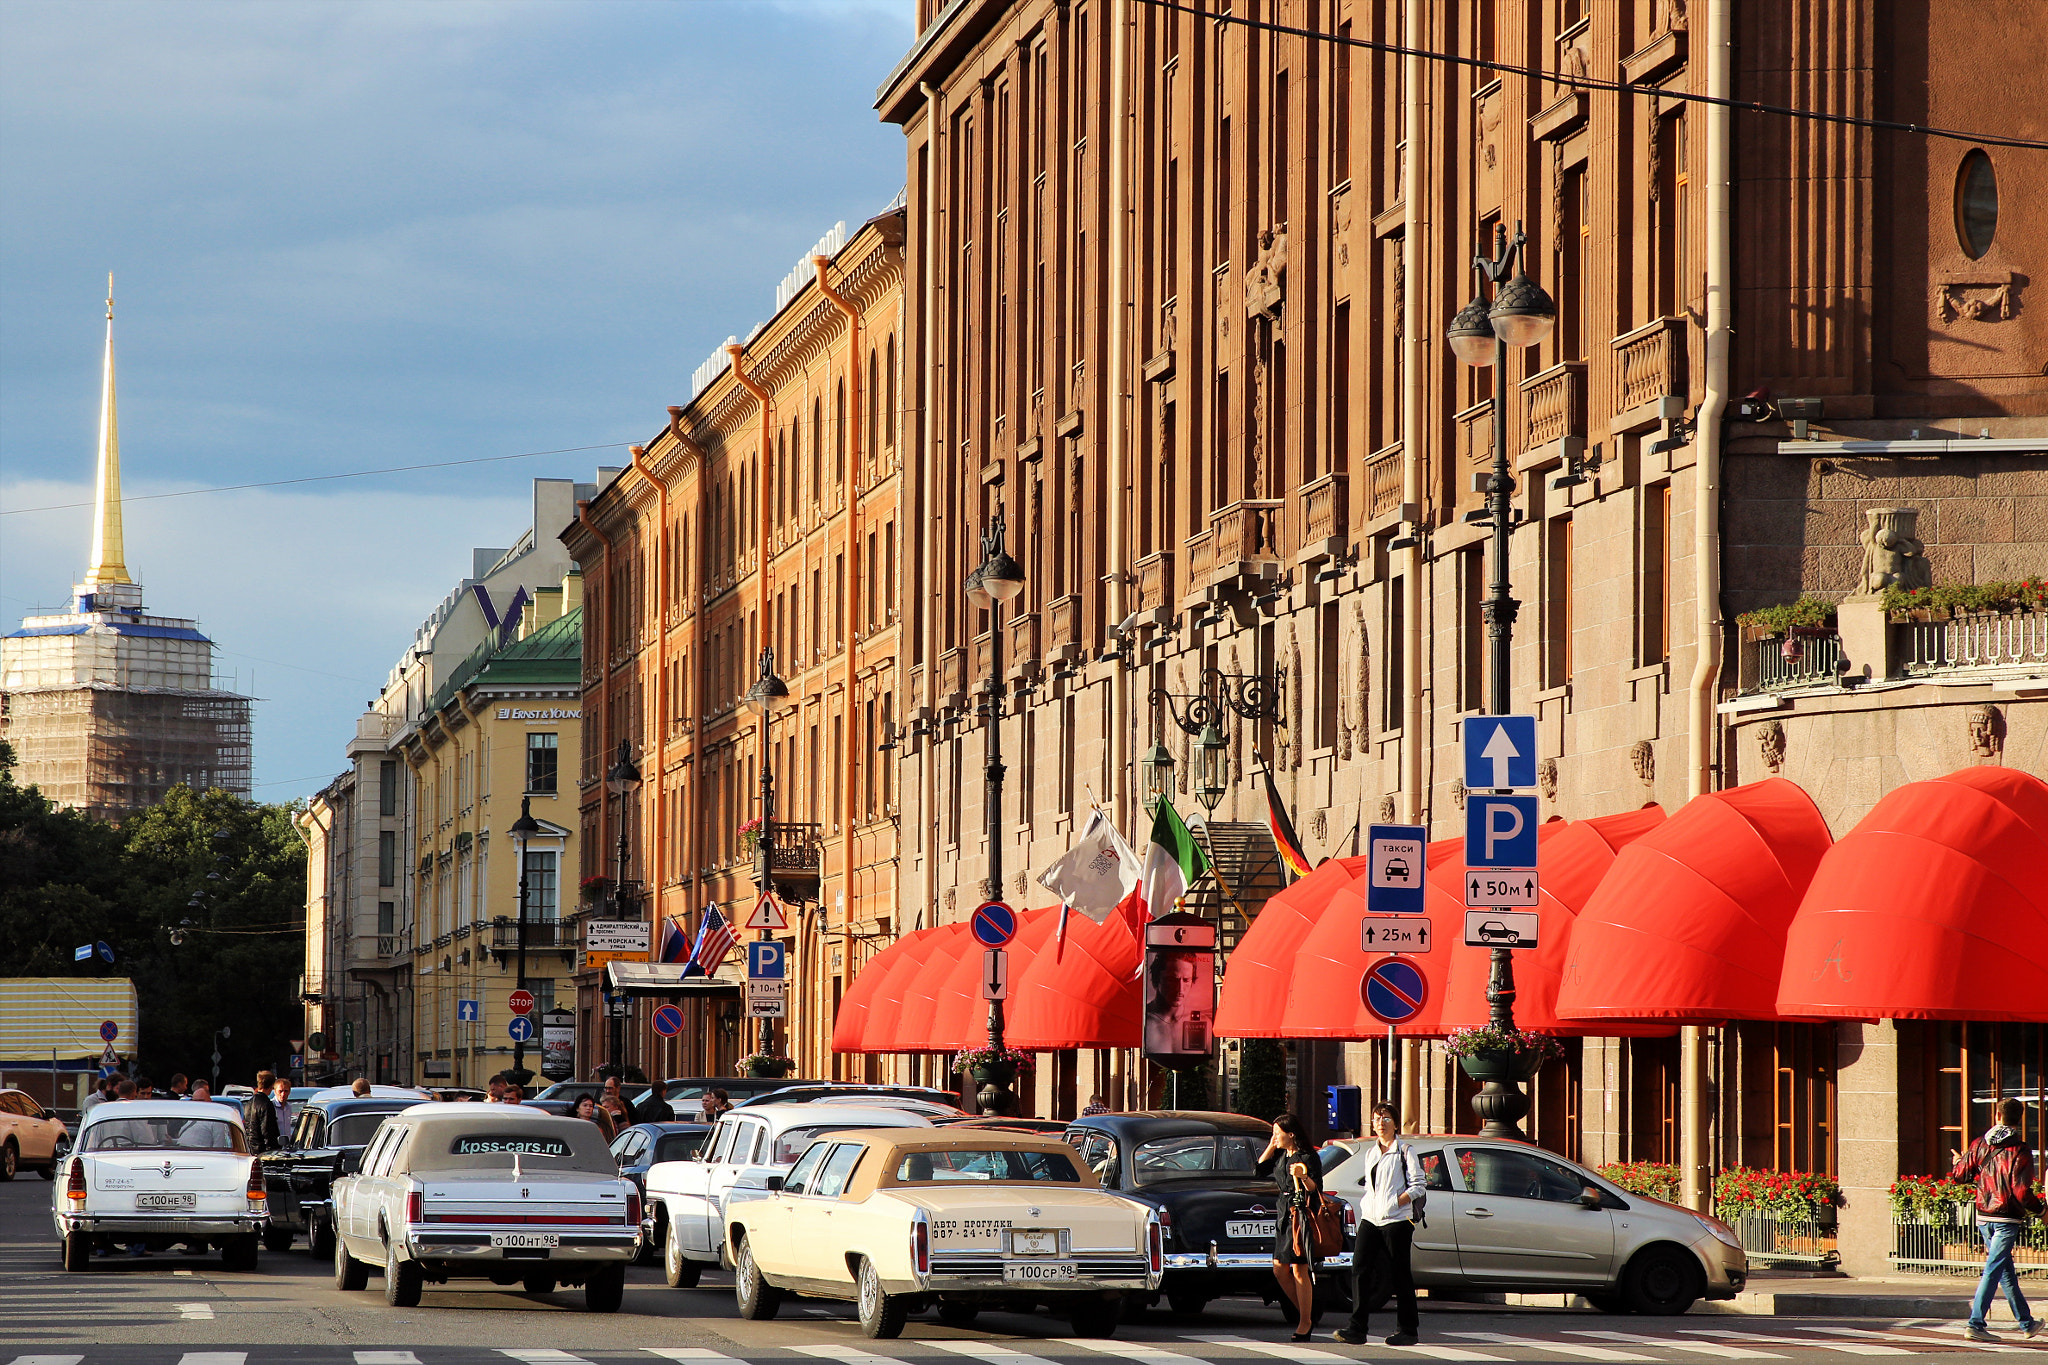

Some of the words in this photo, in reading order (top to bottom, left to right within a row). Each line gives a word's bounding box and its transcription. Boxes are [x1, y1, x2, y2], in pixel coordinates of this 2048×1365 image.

[511, 708, 541, 719] ERNST
[541, 710, 549, 719] &
[1485, 803, 1524, 860] P
[757, 945, 778, 975] P
[510, 998, 533, 1007] STOP
[460, 1140, 563, 1154] kpss-cars.ru
[933, 1220, 957, 1229] АВТО
[963, 1220, 1013, 1228] ПРОГУЛКИ
